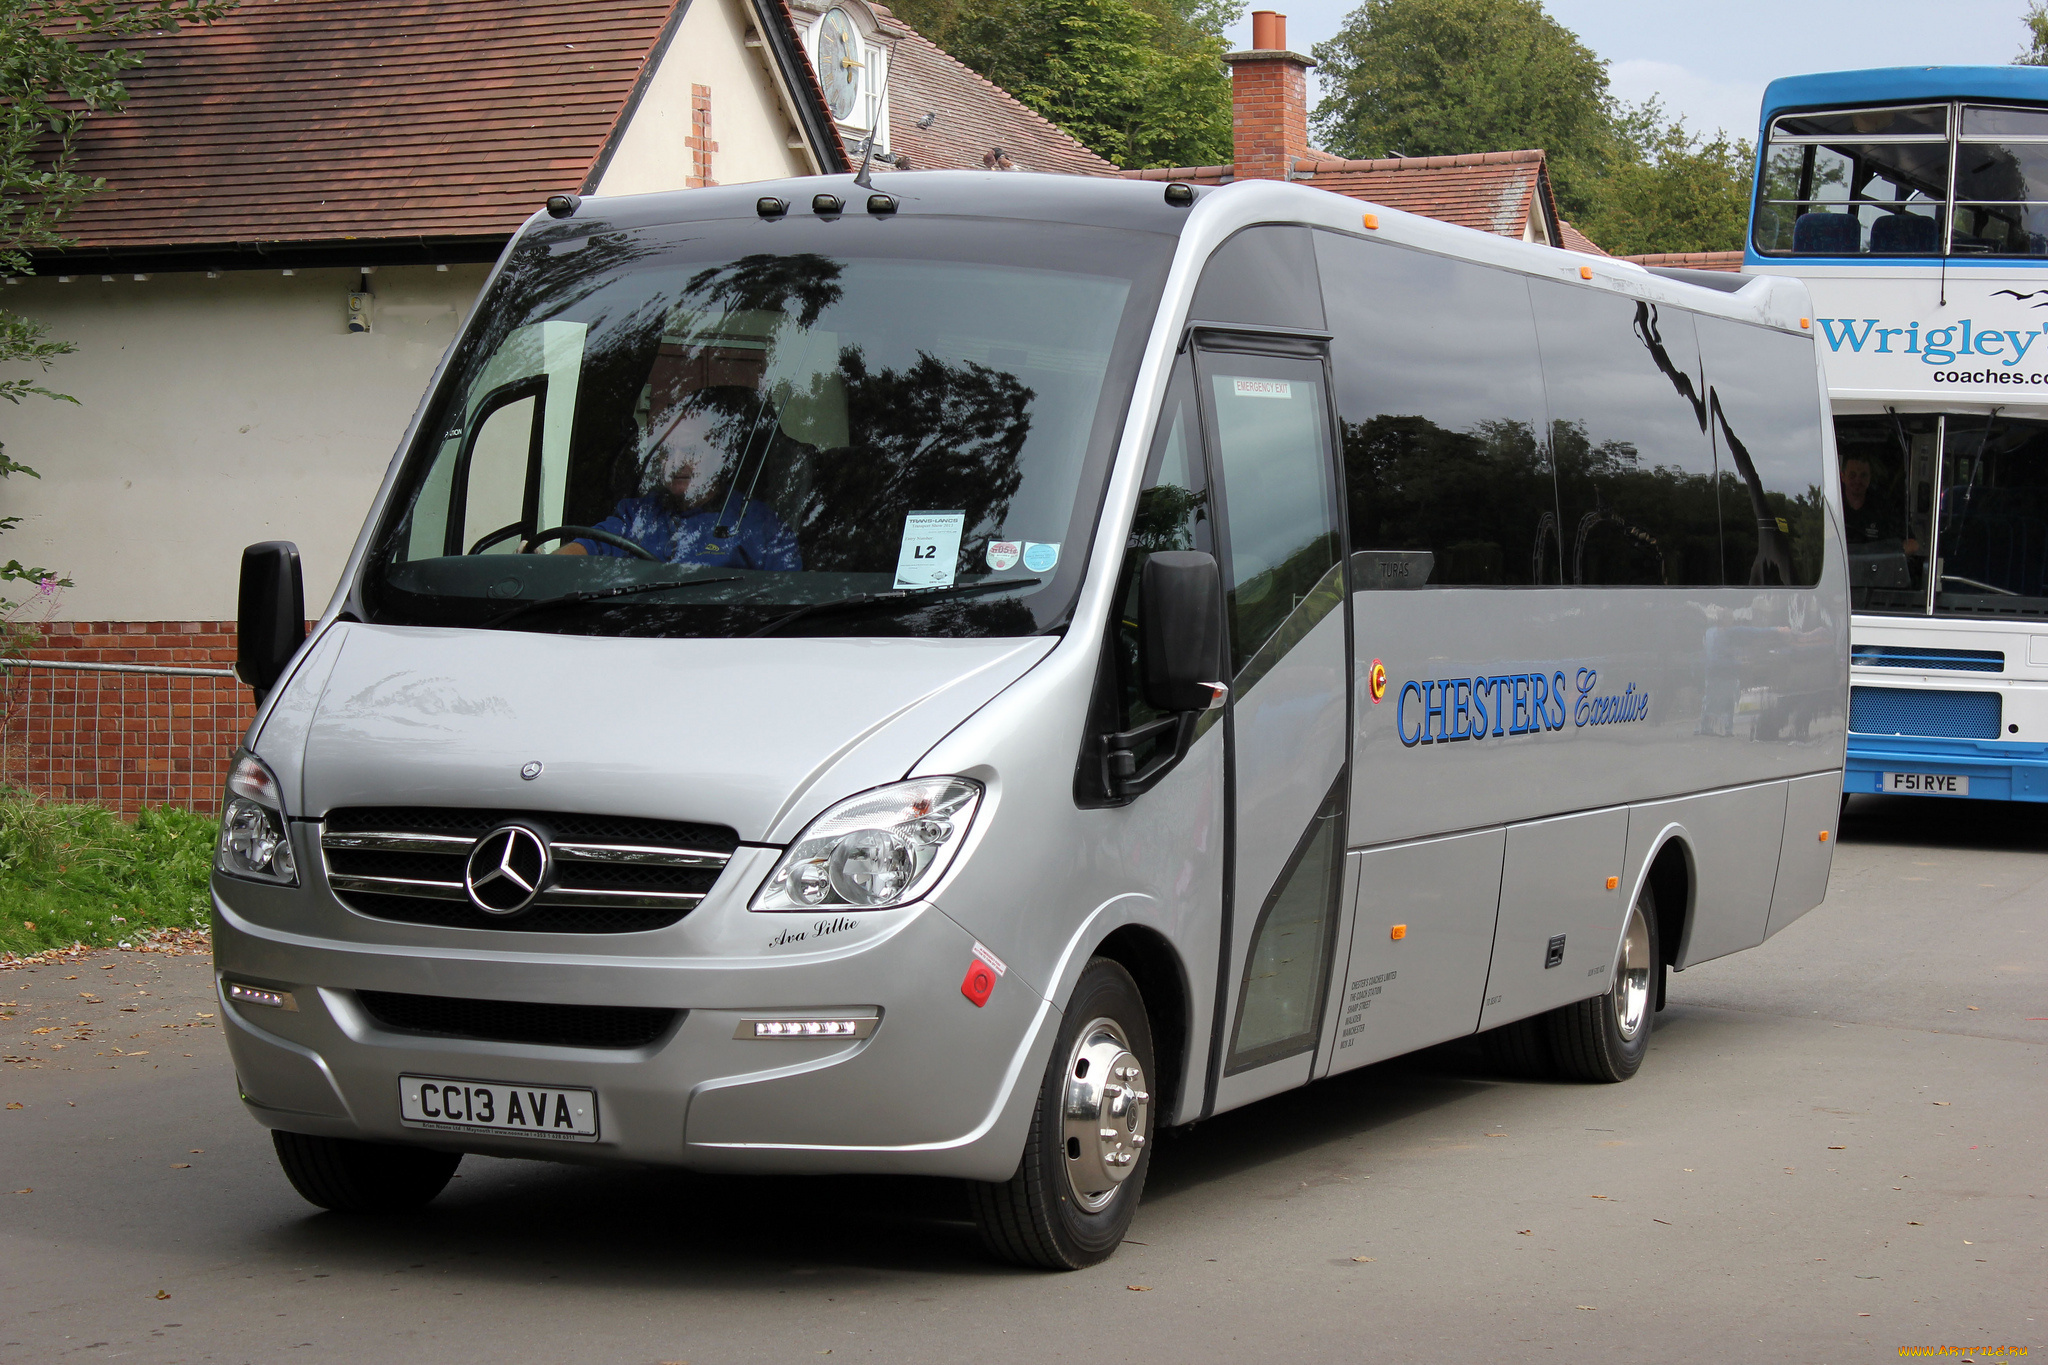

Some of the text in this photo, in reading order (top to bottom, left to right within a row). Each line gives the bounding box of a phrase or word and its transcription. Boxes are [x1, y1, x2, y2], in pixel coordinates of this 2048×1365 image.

[1236, 380, 1288, 394] EMERGENCY EXIT
[914, 545, 937, 559] L2
[1380, 562, 1409, 578] TURAS
[1397, 670, 1566, 748] CHESTERS
[1574, 666, 1649, 728] Executive
[1894, 773, 1957, 792] F51 RYE
[768, 916, 861, 949] Ava Lillie
[420, 1083, 573, 1129] CC13 AVA
[466, 1126, 491, 1134] Maynooth
